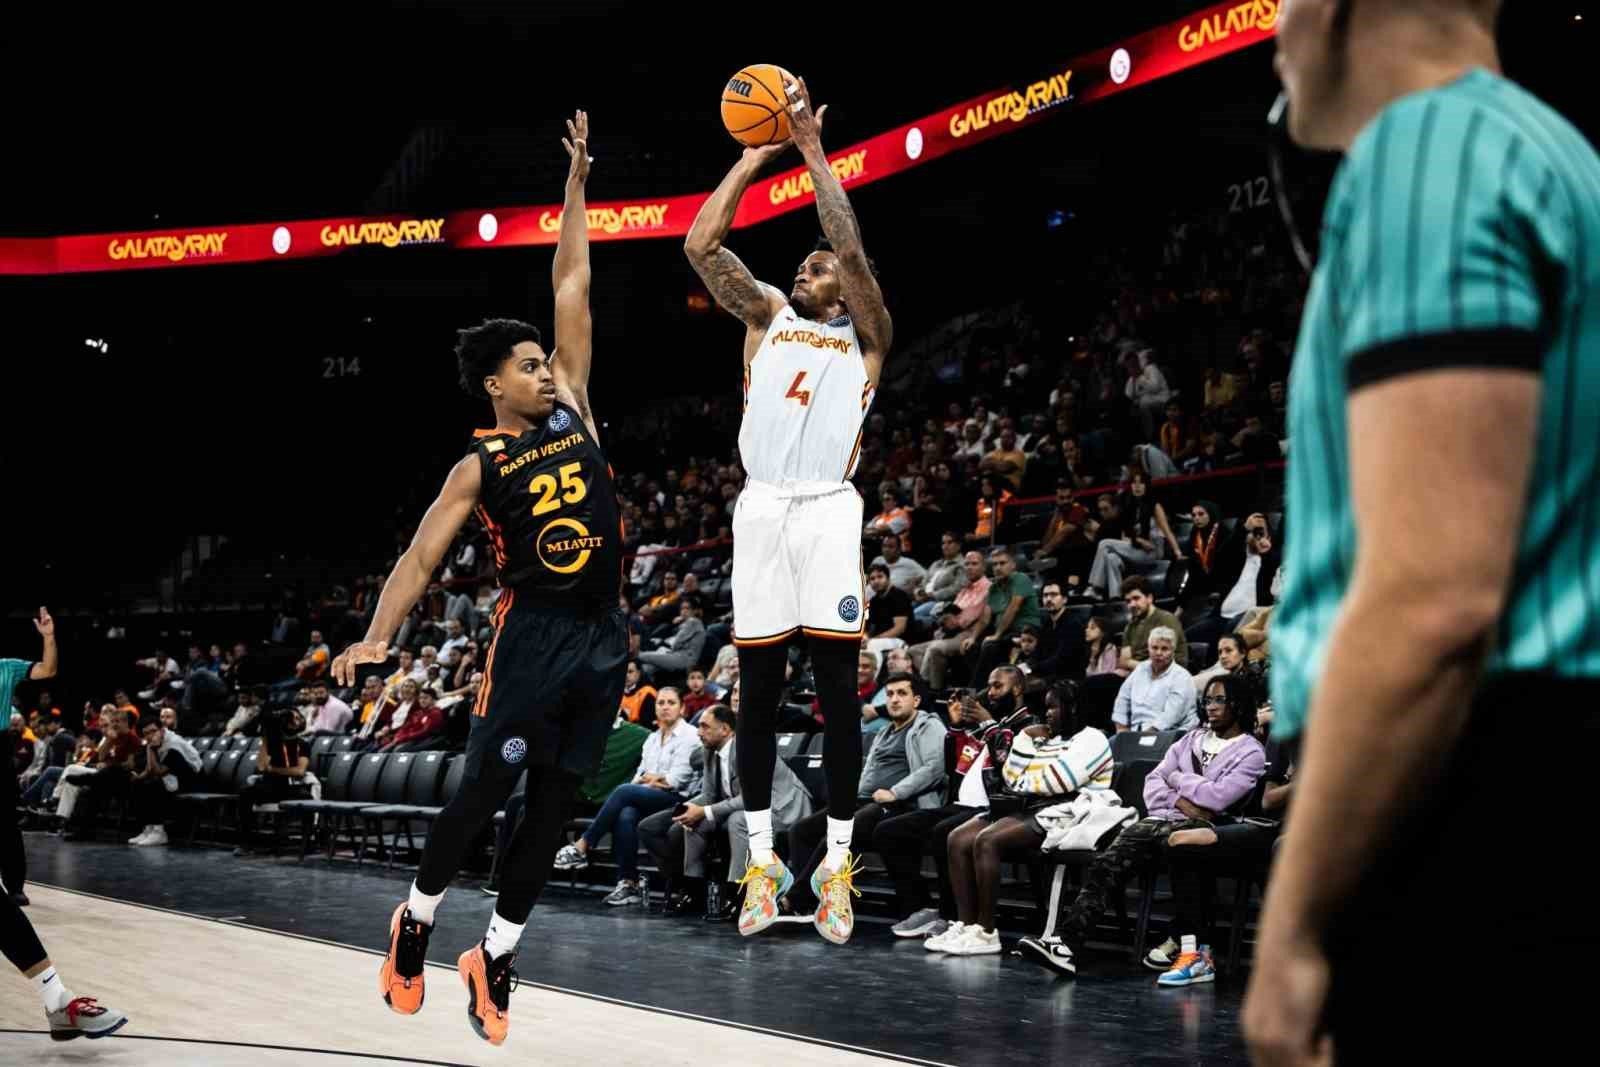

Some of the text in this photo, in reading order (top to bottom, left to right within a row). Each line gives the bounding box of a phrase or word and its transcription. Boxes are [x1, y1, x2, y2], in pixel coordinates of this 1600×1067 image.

[1178, 0, 1278, 52] GALATAS
[949, 70, 1072, 137] GALATASARAY
[1227, 176, 1270, 211] 212
[108, 232, 228, 261] GALATASARAY
[320, 218, 444, 247] GALATASARAY
[322, 356, 361, 378] 214
[785, 371, 810, 406] 4
[500, 432, 585, 477] RASTA VECHTA
[528, 461, 587, 516] 25
[546, 536, 603, 553] MIAVIT
